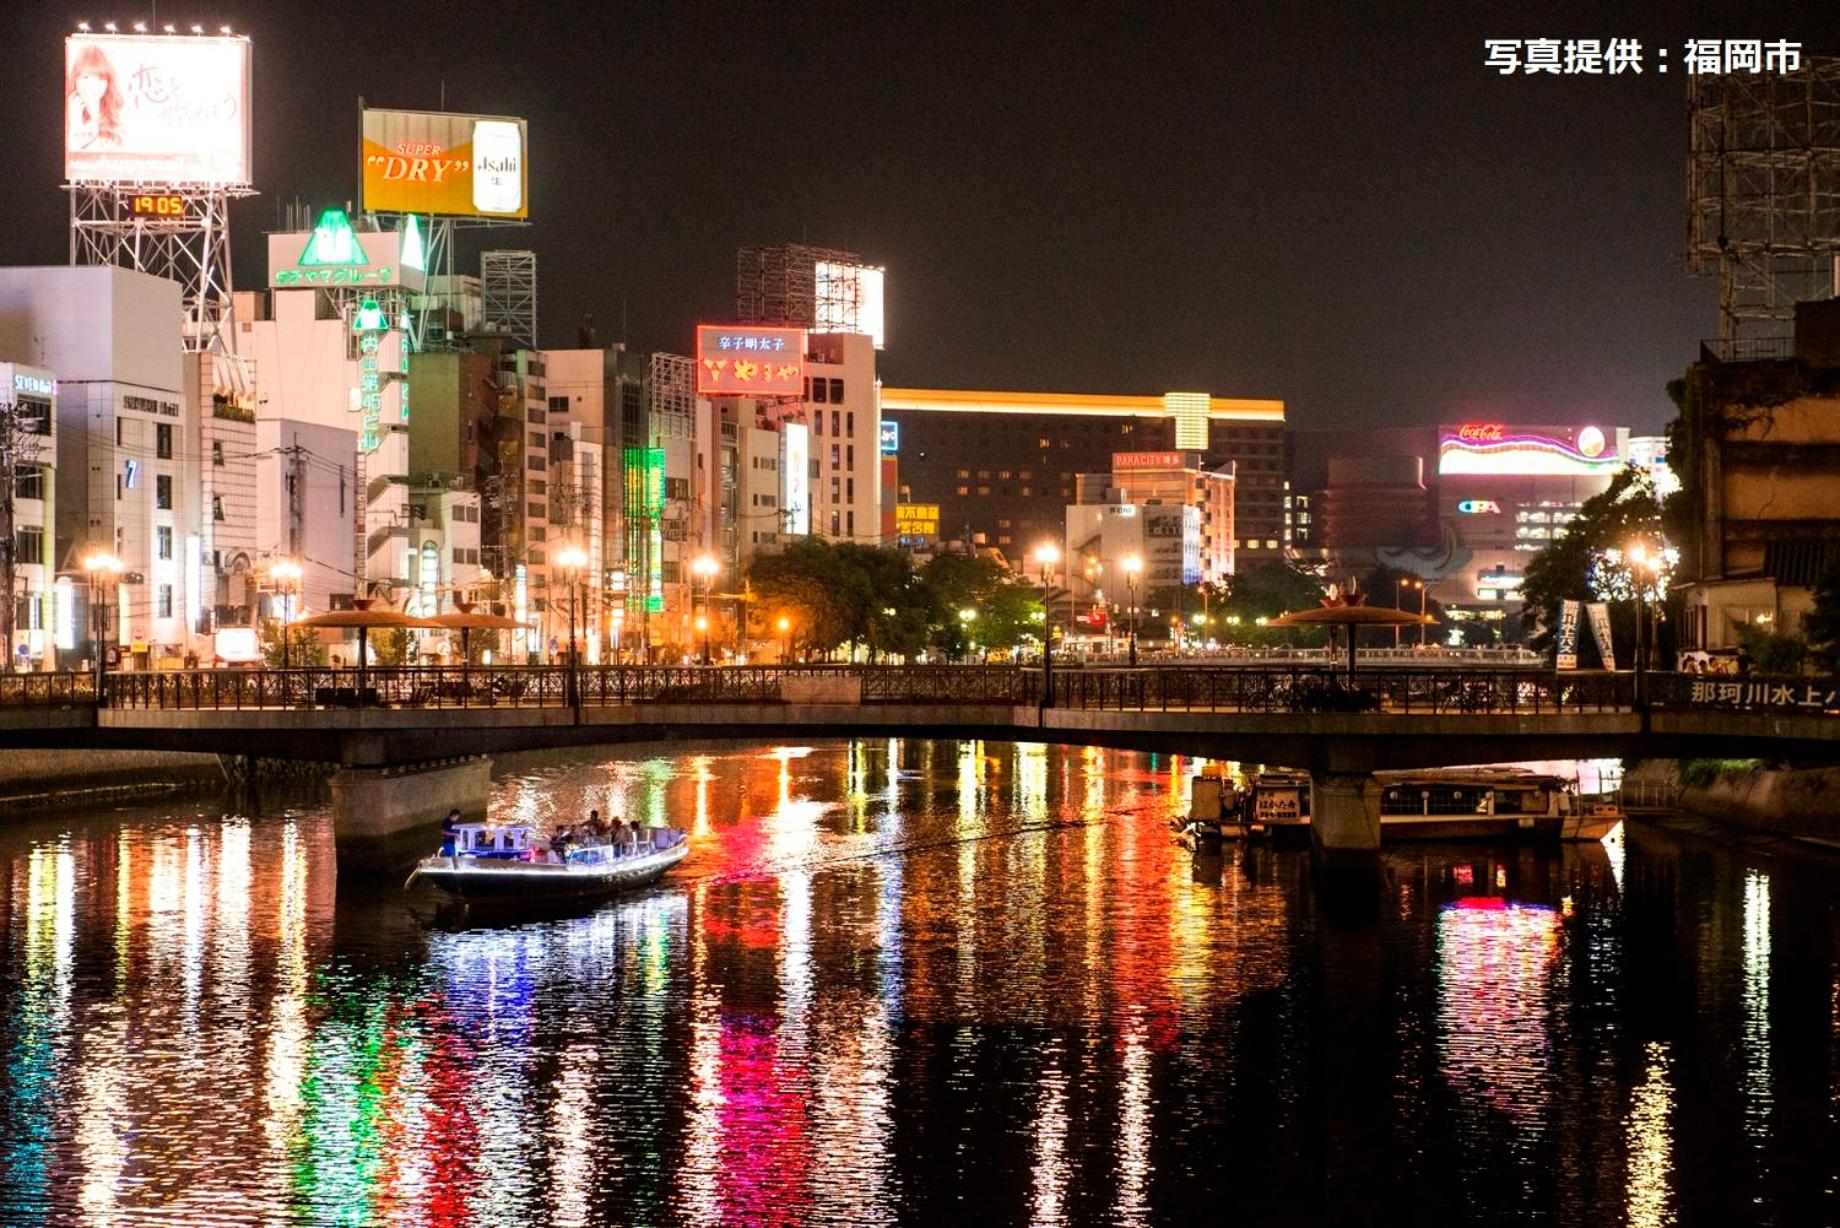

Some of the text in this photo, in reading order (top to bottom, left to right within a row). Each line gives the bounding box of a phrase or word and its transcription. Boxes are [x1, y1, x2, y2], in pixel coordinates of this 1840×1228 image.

[397, 143, 441, 155] SUPER
[478, 156, 517, 173] Asahi
[719, 336, 785, 351] 辛子明太子
